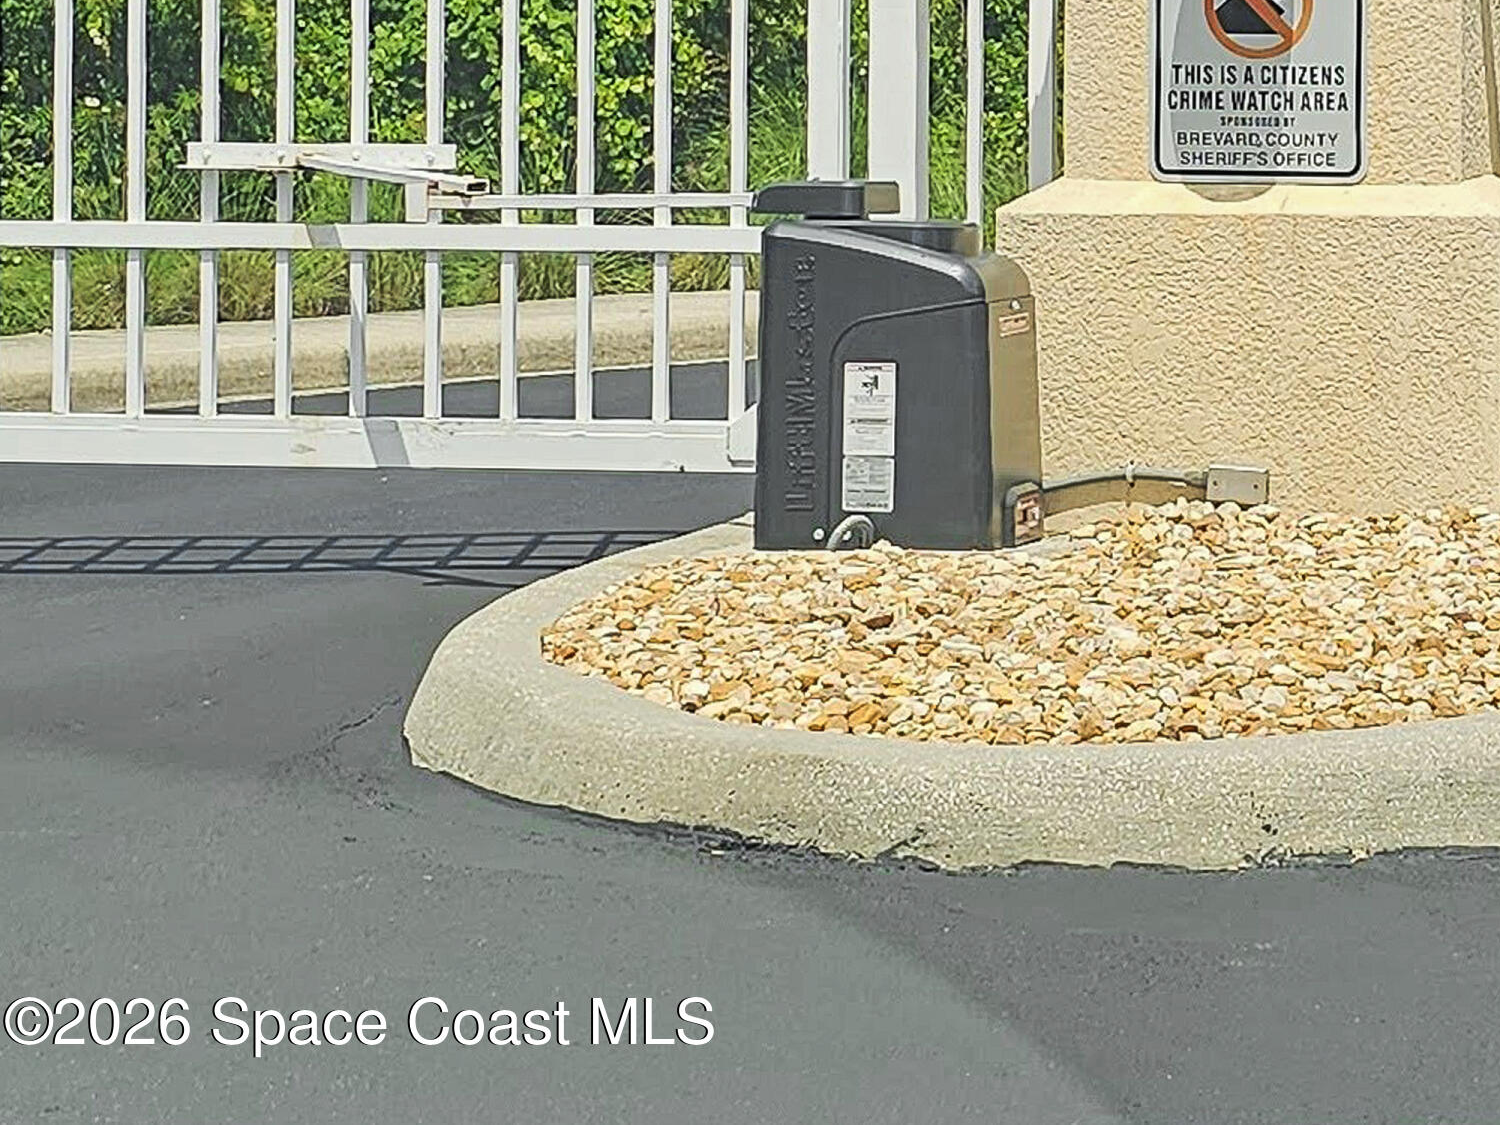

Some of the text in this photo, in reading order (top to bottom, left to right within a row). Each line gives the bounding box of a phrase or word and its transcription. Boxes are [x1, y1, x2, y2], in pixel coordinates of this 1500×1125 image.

[1171, 65, 1345, 85] THIS IS A CITIZENS
[1168, 91, 1349, 111] CRIME WATCH AREA
[1220, 116, 1280, 127] SPONSORED
[1176, 132, 1339, 147] BREVARD COUNTY
[1180, 151, 1336, 167] SHERIFF'S OFFICE
